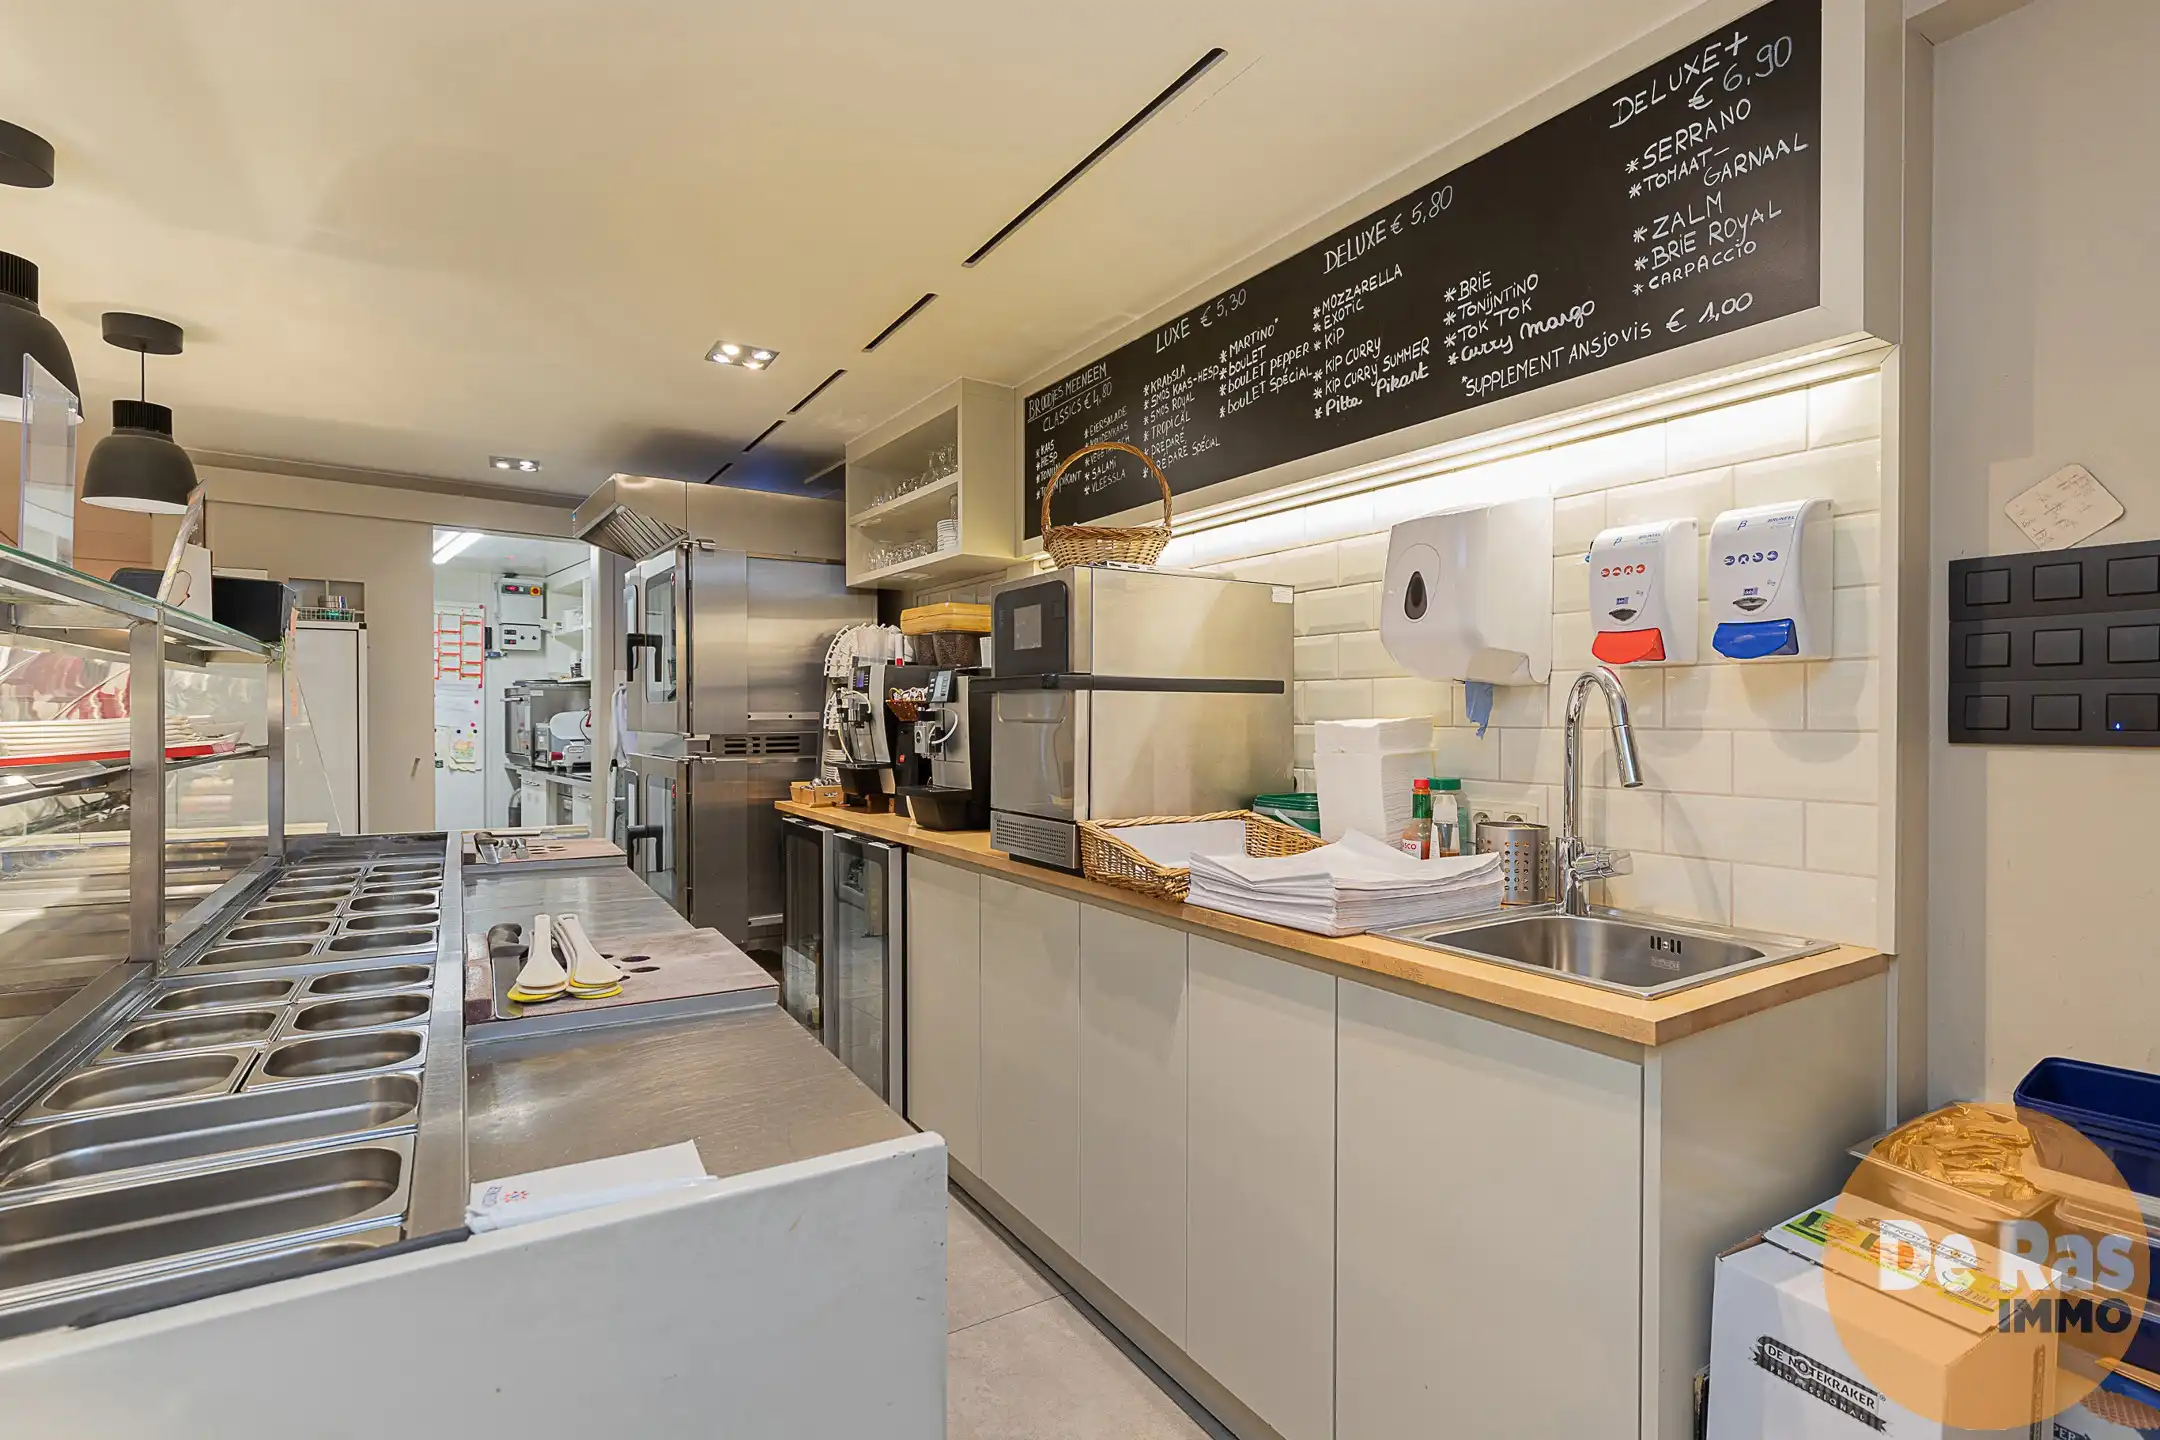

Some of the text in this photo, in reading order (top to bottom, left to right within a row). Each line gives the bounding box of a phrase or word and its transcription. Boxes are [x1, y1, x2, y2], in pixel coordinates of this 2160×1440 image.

[1688, 36, 1793, 110] € 6,90
[1642, 98, 1751, 170] SERRANO
[1704, 132, 1809, 187] GARNAAL
[1323, 185, 1453, 275] DELUXE € 5,80
[1652, 190, 1723, 240] ZALM
[1322, 263, 1403, 315] MOZZARELLA
[1156, 288, 1247, 354] LUXE € 5,30
[1457, 297, 1533, 342] TOK TOK
[1466, 346, 1565, 397] SUPPLEMENT
[1665, 308, 1687, 333] €
[1698, 292, 1753, 323] 1,00
[1065, 362, 1107, 396] MEENEEM
[1382, 336, 1430, 372] SUMMER
[1042, 398, 1082, 432] CLASSICS
[1093, 381, 1113, 406] 4,80
[1768, 1345, 1875, 1409] DE NOTEKRAKER
[1770, 1365, 1865, 1421] PROFESSIONAL
